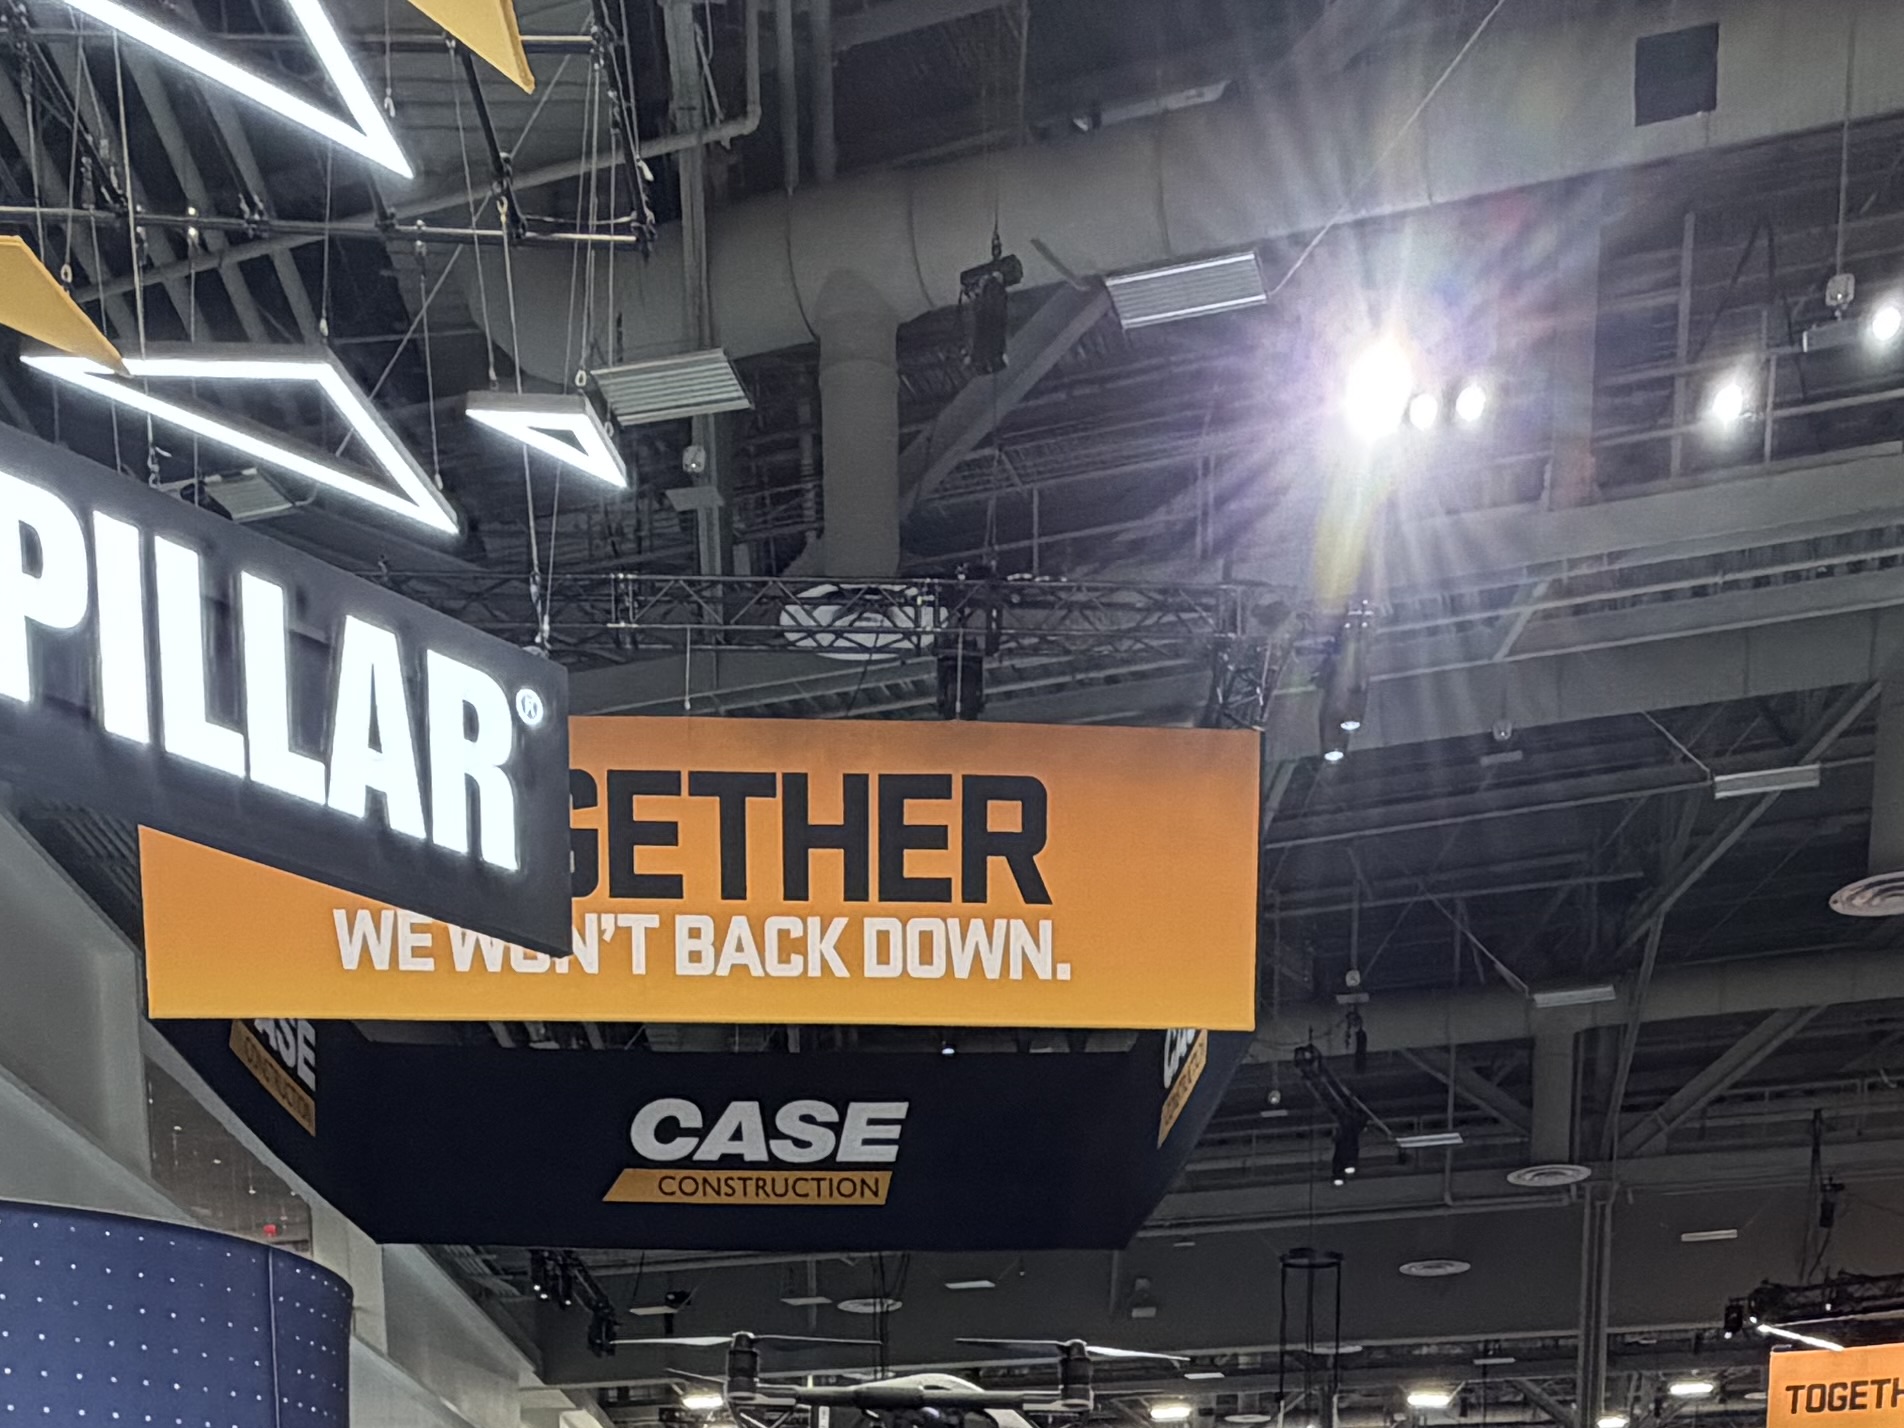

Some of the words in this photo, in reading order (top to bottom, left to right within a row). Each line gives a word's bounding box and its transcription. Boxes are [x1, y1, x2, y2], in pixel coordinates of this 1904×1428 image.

[333, 908, 437, 972] WE
[674, 913, 850, 979] BACK
[861, 916, 1072, 983] DOWN.
[629, 1100, 908, 1164] CASE
[656, 1173, 883, 1201] CONSTRUCTION
